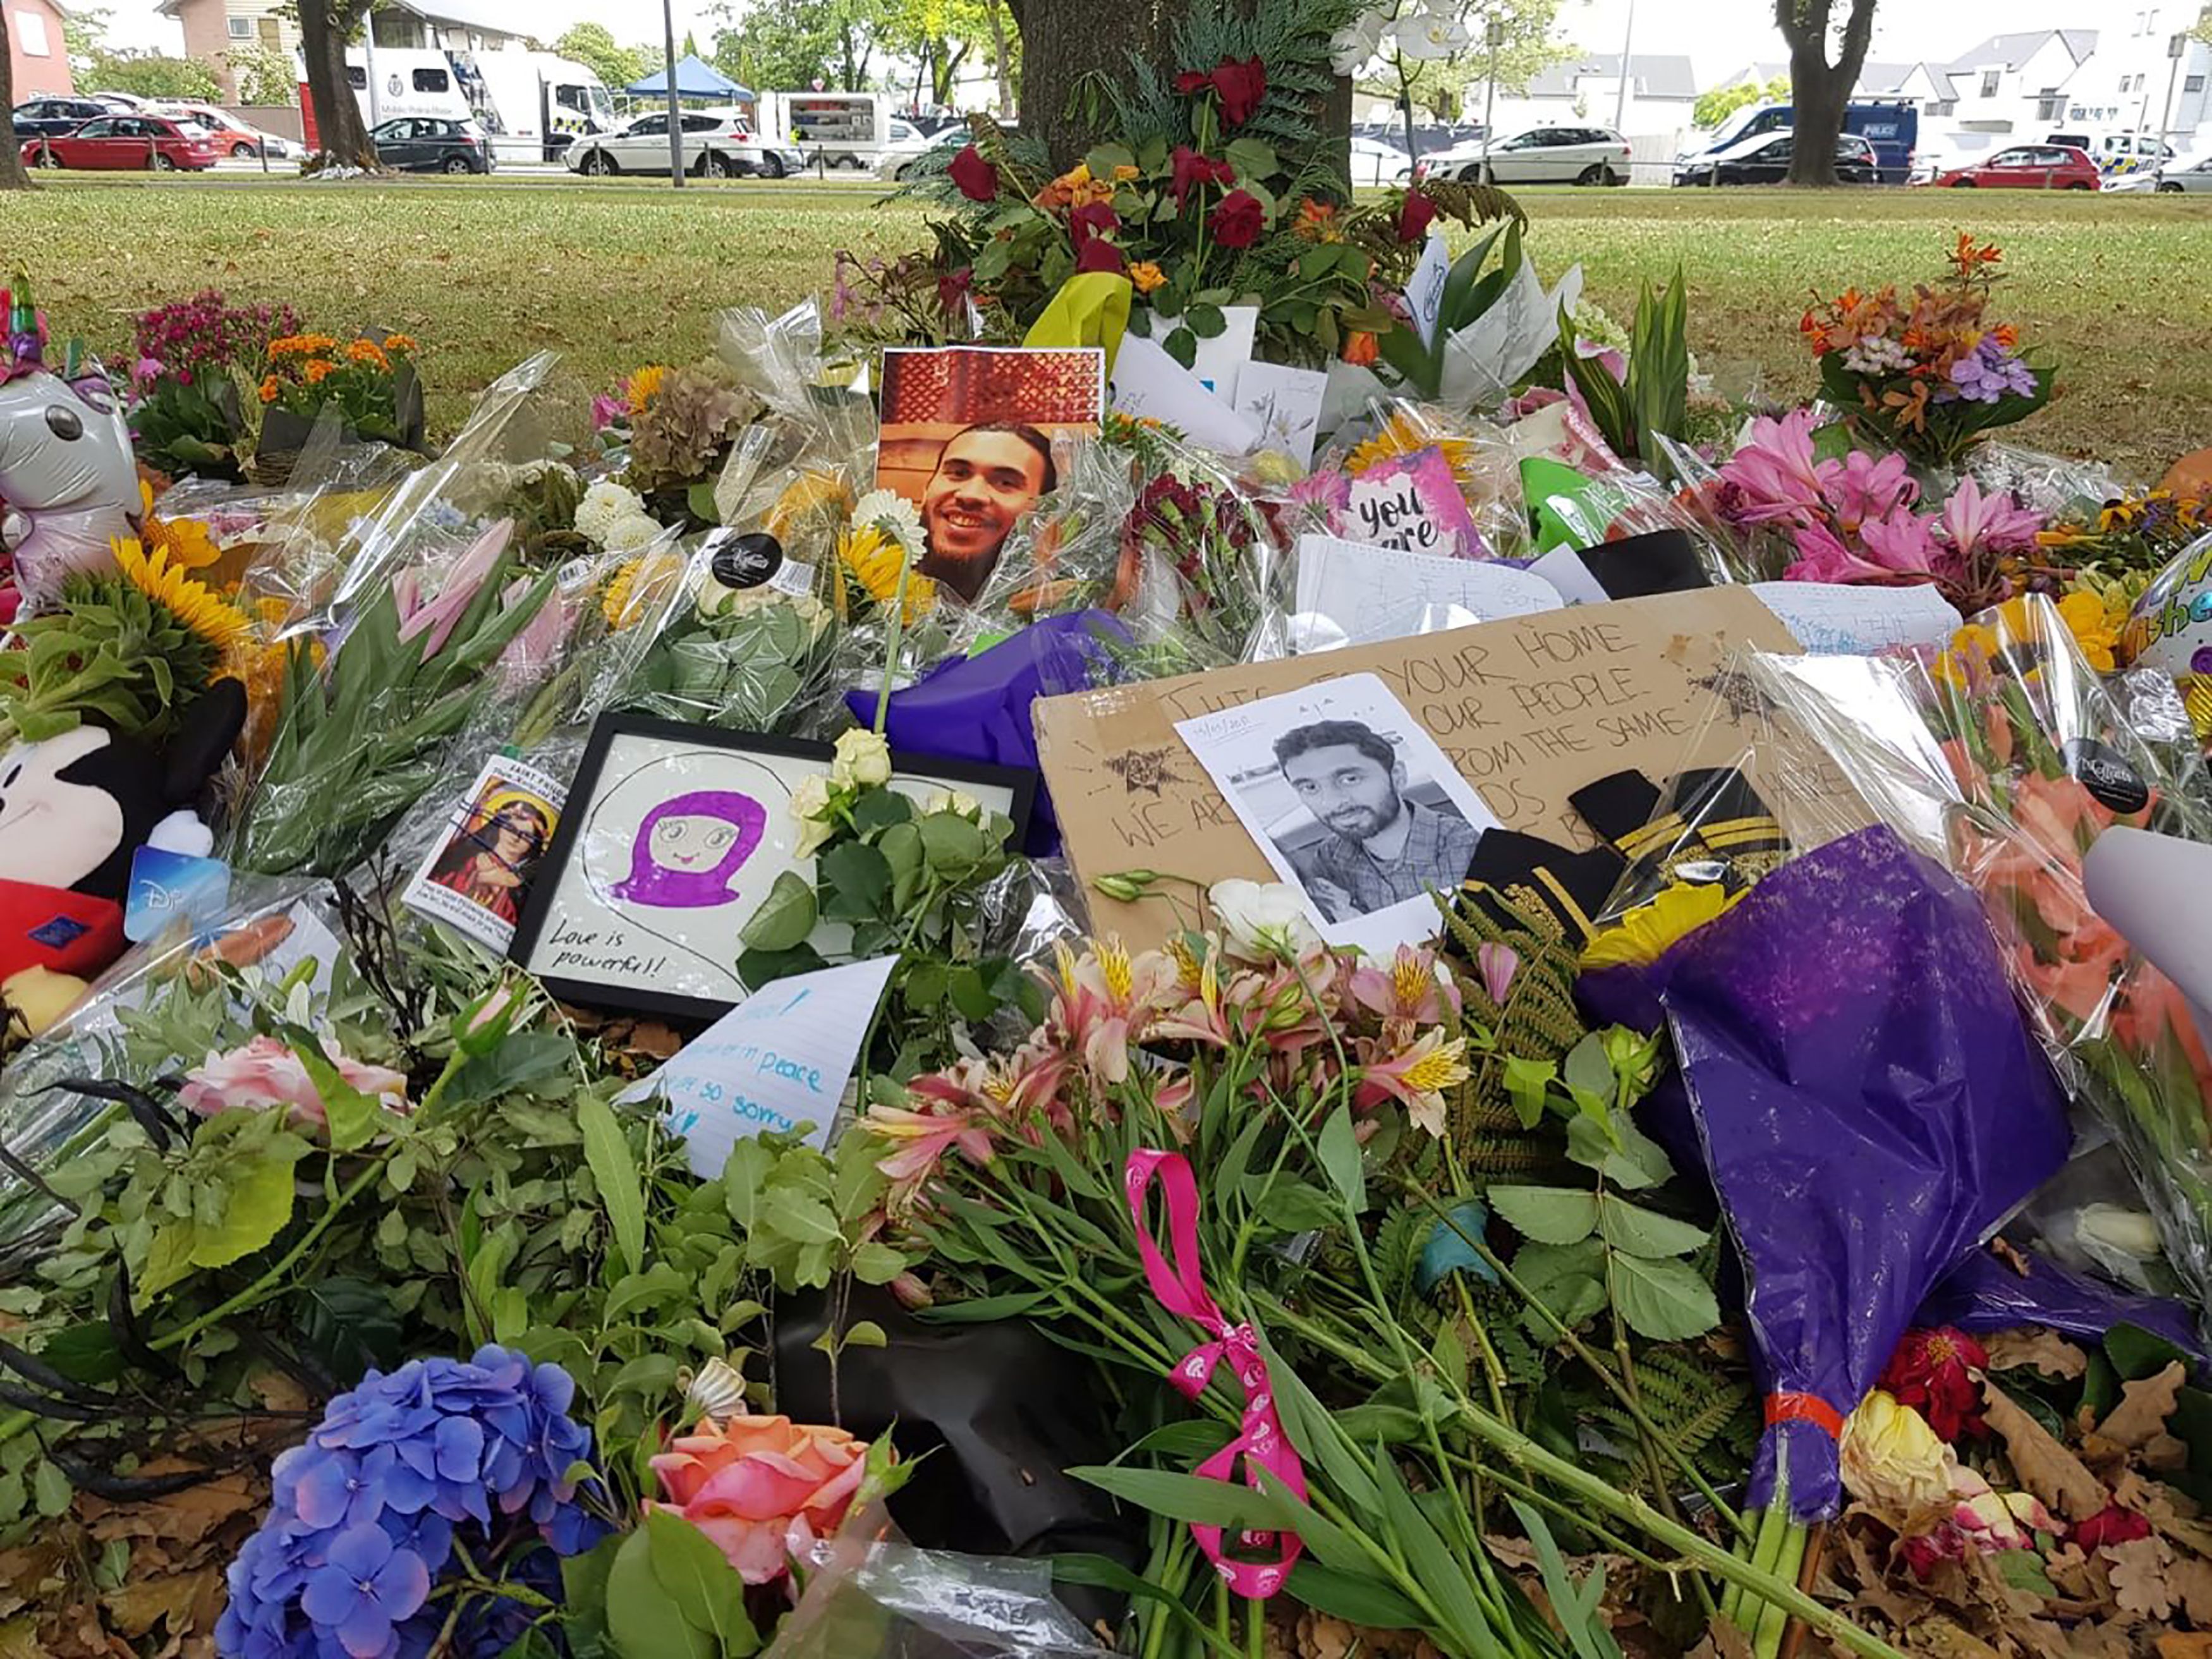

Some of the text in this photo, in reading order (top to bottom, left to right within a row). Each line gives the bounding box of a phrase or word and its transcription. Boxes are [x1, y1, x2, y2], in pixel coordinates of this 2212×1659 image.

[1359, 487, 1425, 538] you
[1376, 645, 1517, 697] YOUR
[1514, 622, 1640, 669] HOME
[1422, 668, 1652, 735] OUR PEOPLE
[1442, 707, 1695, 778] ROM THE SAME
[1111, 792, 1239, 848] WE AR
[549, 918, 625, 947] Love is
[550, 951, 667, 978] powerful!
[758, 1051, 823, 1094] peace
[698, 1078, 724, 1101] so
[732, 1093, 795, 1133] sorry
